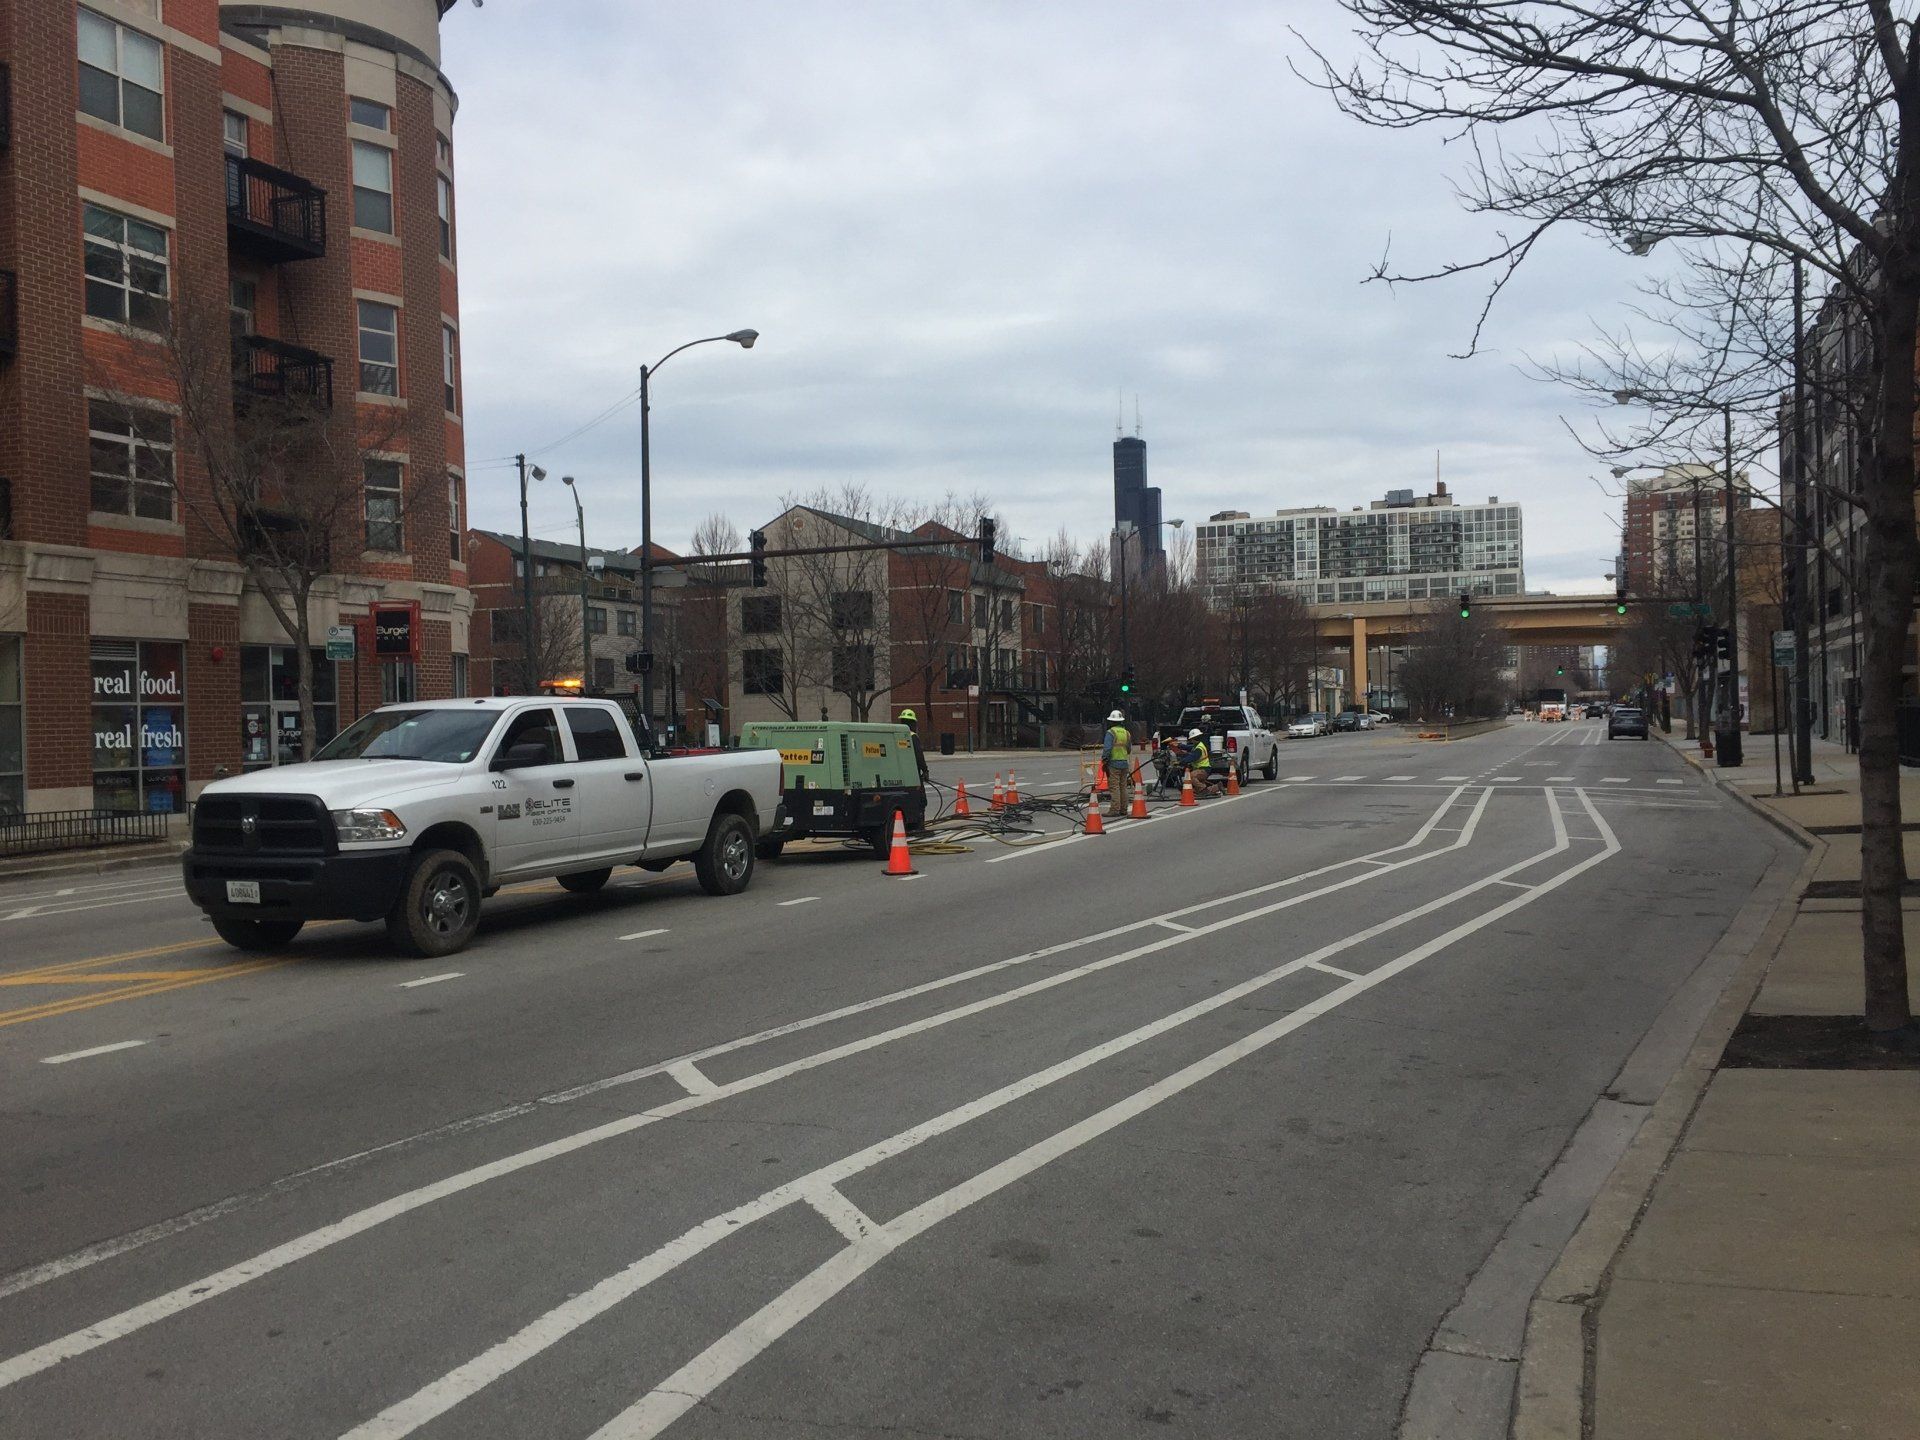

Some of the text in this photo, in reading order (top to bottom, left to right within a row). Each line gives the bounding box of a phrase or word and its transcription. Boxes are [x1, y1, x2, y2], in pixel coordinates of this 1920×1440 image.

[376, 626, 409, 636] Burger
[93, 670, 181, 695] real food.
[94, 723, 183, 749] real fresh
[811, 753, 824, 762] CAT
[491, 779, 507, 790] 122
[533, 797, 571, 809] ELITE
